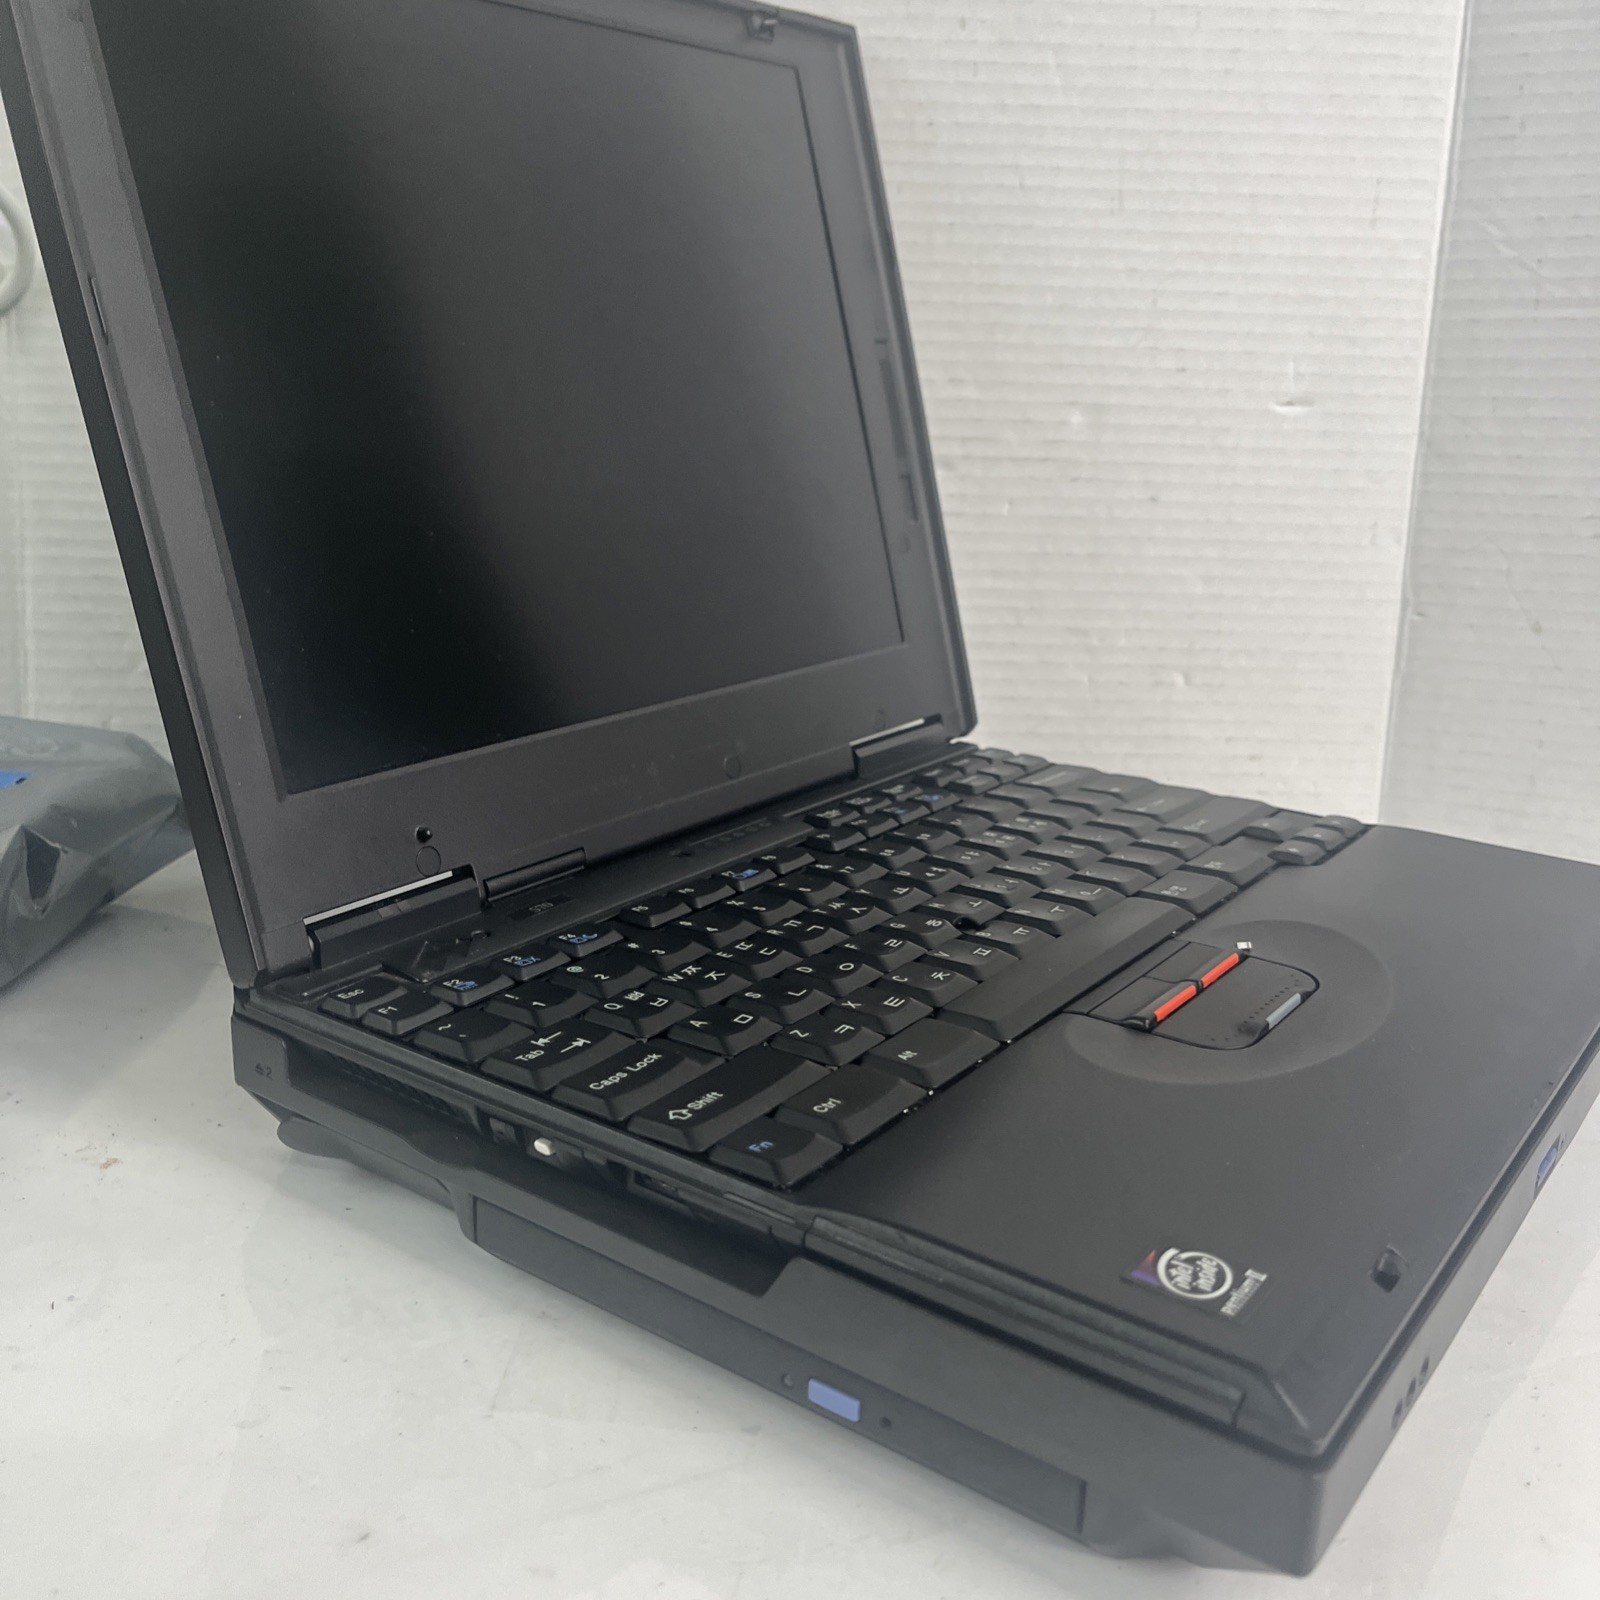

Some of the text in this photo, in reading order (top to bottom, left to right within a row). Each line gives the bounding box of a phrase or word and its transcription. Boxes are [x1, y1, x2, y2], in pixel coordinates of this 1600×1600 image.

[926, 919, 942, 927] ㅎ
[1013, 927, 1030, 936] ㅠ
[558, 934, 577, 942] F4
[735, 941, 753, 950] ㄸ
[884, 940, 902, 948] ㄹ
[759, 948, 777, 956] ㄷ
[503, 956, 522, 964] F3
[566, 965, 584, 974] @
[682, 965, 702, 975] ㅉ
[662, 973, 684, 982] W
[705, 971, 725, 981] ㅈ
[931, 971, 949, 980] ㅊ
[443, 979, 462, 989] F2
[338, 988, 364, 999] Esc
[625, 991, 644, 1000] ㅃ
[604, 1002, 622, 1010] Q
[649, 997, 669, 1007] ㅂ
[883, 997, 905, 1007] ㅌ
[378, 1006, 398, 1015] F1
[790, 1029, 809, 1037] Z
[834, 1024, 855, 1034] ㅋ
[516, 1049, 544, 1062] Tab
[898, 1049, 917, 1061] Alt
[589, 1052, 662, 1090] Caps Lock
[688, 1091, 723, 1110] Shift
[813, 1098, 841, 1113] Ctrl
[749, 1140, 773, 1152] Fn
